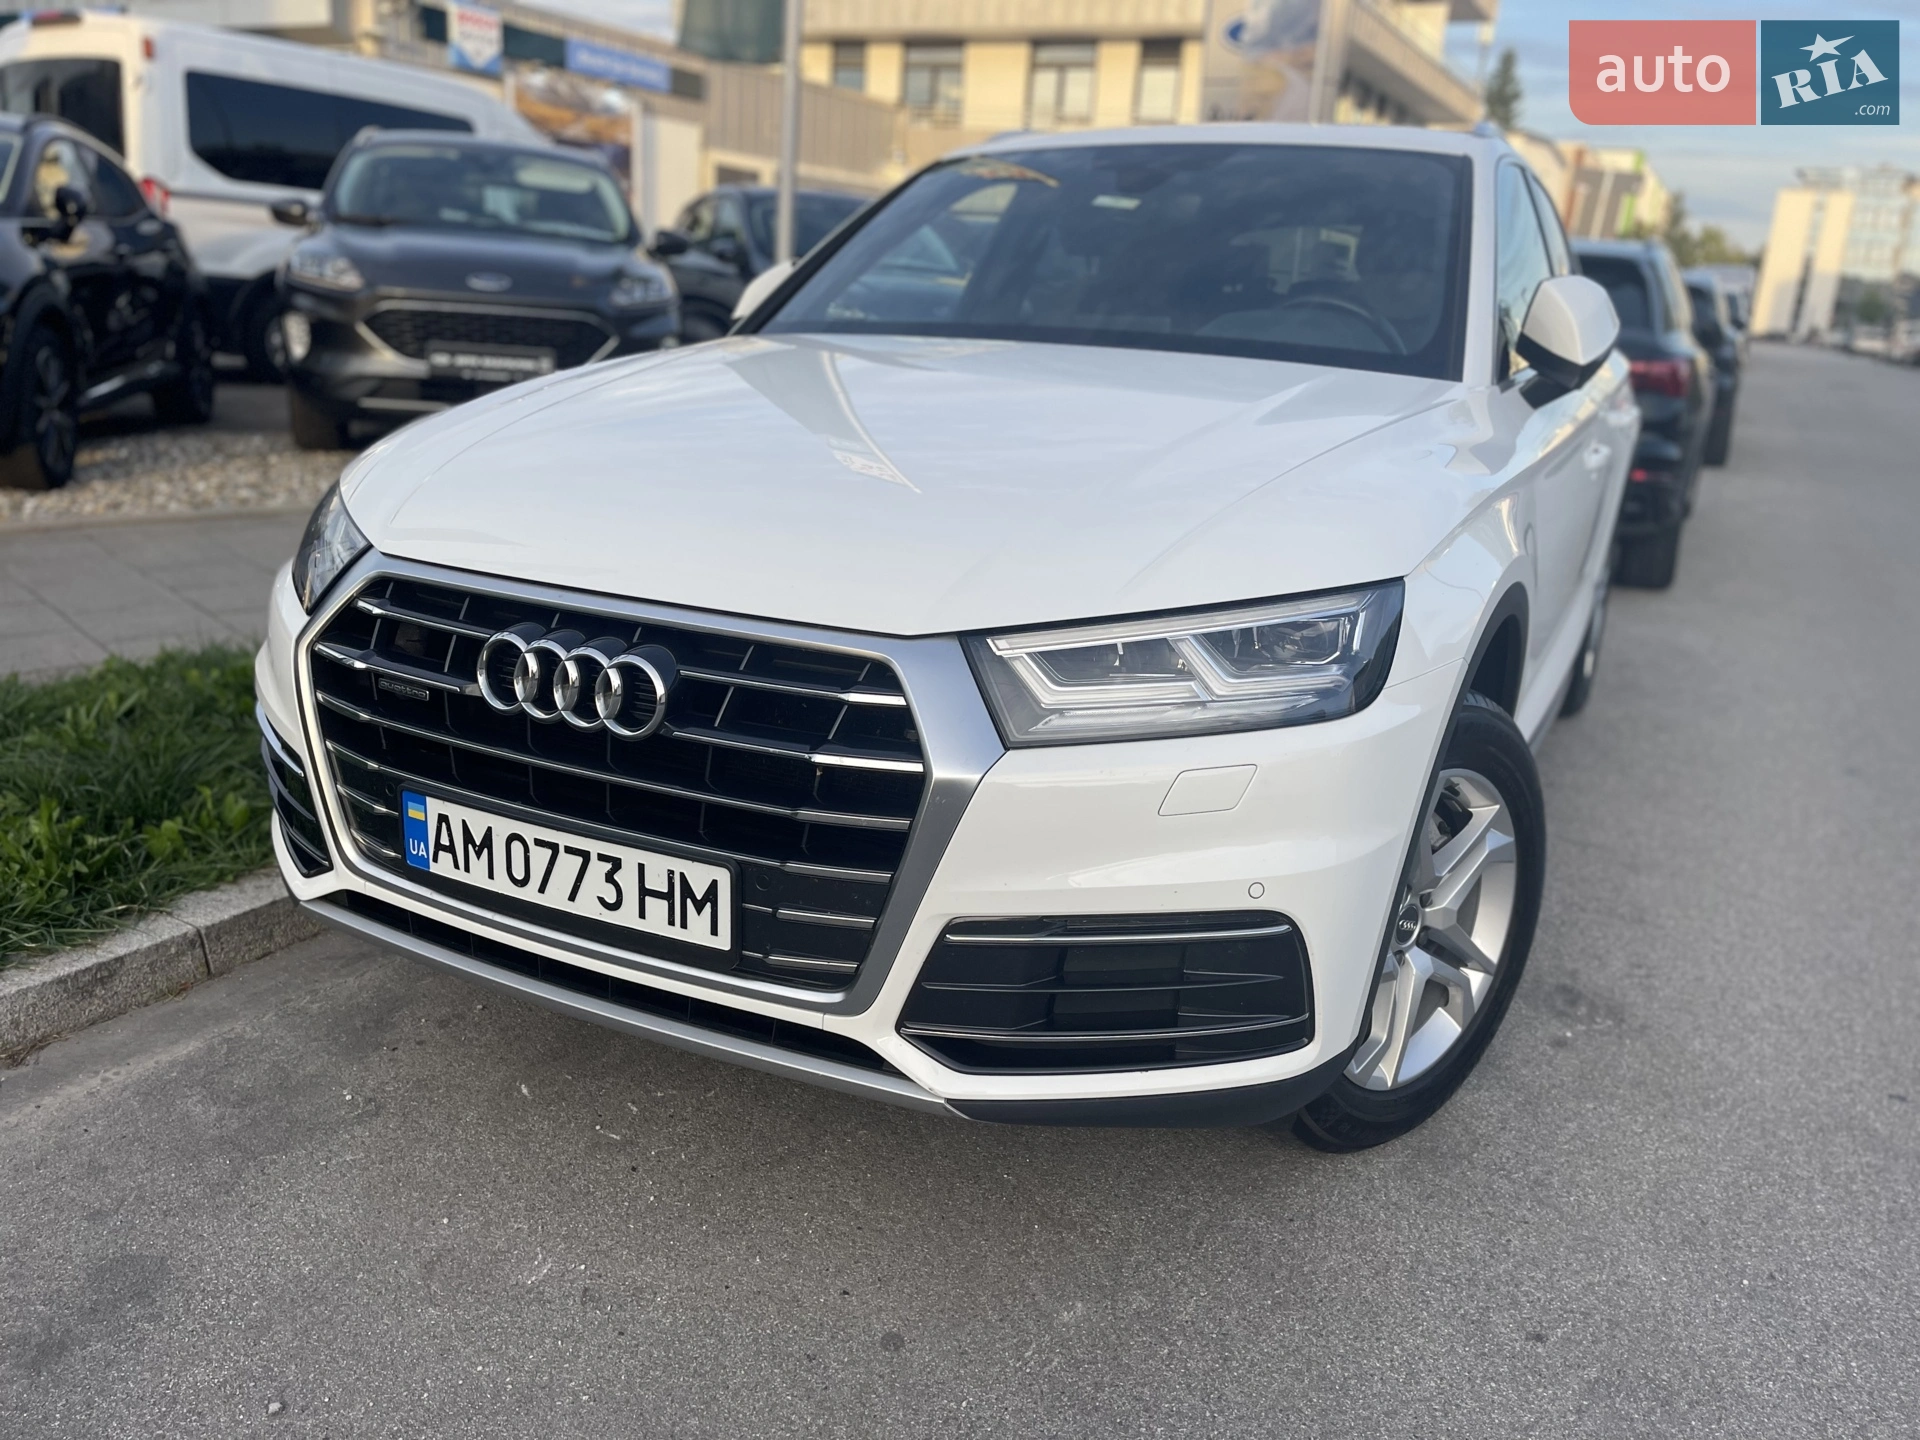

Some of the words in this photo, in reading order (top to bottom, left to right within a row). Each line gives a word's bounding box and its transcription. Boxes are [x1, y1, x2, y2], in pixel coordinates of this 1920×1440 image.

[379, 680, 427, 698] quattro
[408, 839, 428, 859] UA
[431, 812, 496, 881] AM
[505, 832, 625, 912] 0773
[637, 861, 720, 937] HM
